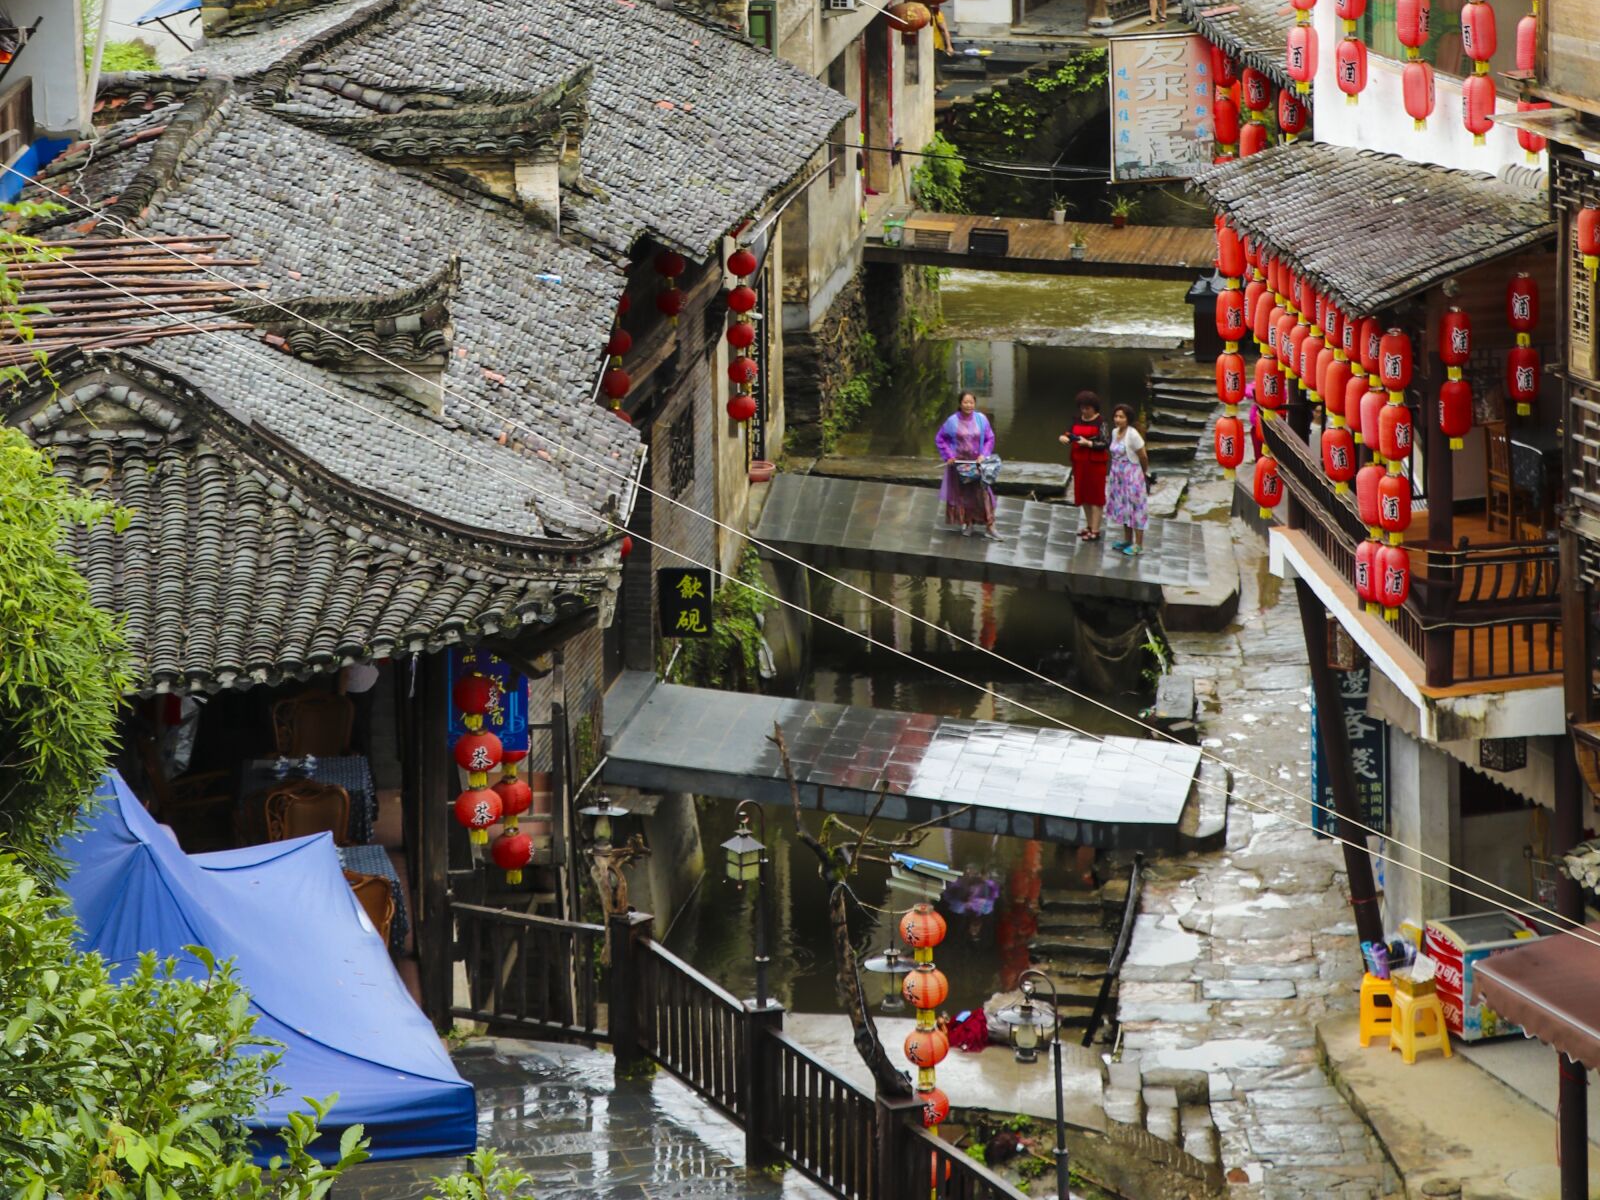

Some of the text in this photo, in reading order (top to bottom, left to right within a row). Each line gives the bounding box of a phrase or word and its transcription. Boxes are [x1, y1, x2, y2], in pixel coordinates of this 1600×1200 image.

[1340, 60, 1357, 84] 酒
[1284, 101, 1298, 126] 酒
[1227, 307, 1241, 329] 酒
[1512, 294, 1530, 320] 酒
[1452, 328, 1468, 353] 酒
[1385, 353, 1402, 379] 酒
[1226, 372, 1239, 392] 酒
[1264, 374, 1278, 396] 酒
[1517, 367, 1533, 392] 酒
[1221, 435, 1234, 457] 酒
[1396, 423, 1411, 448] 酒
[1331, 446, 1347, 470] 酒
[1264, 473, 1279, 495] 酒
[1383, 495, 1399, 521] 酒
[1386, 566, 1404, 593] 酒
[471, 747, 493, 770] 茶
[472, 802, 494, 825] 茶
[909, 1041, 924, 1064] 茶
